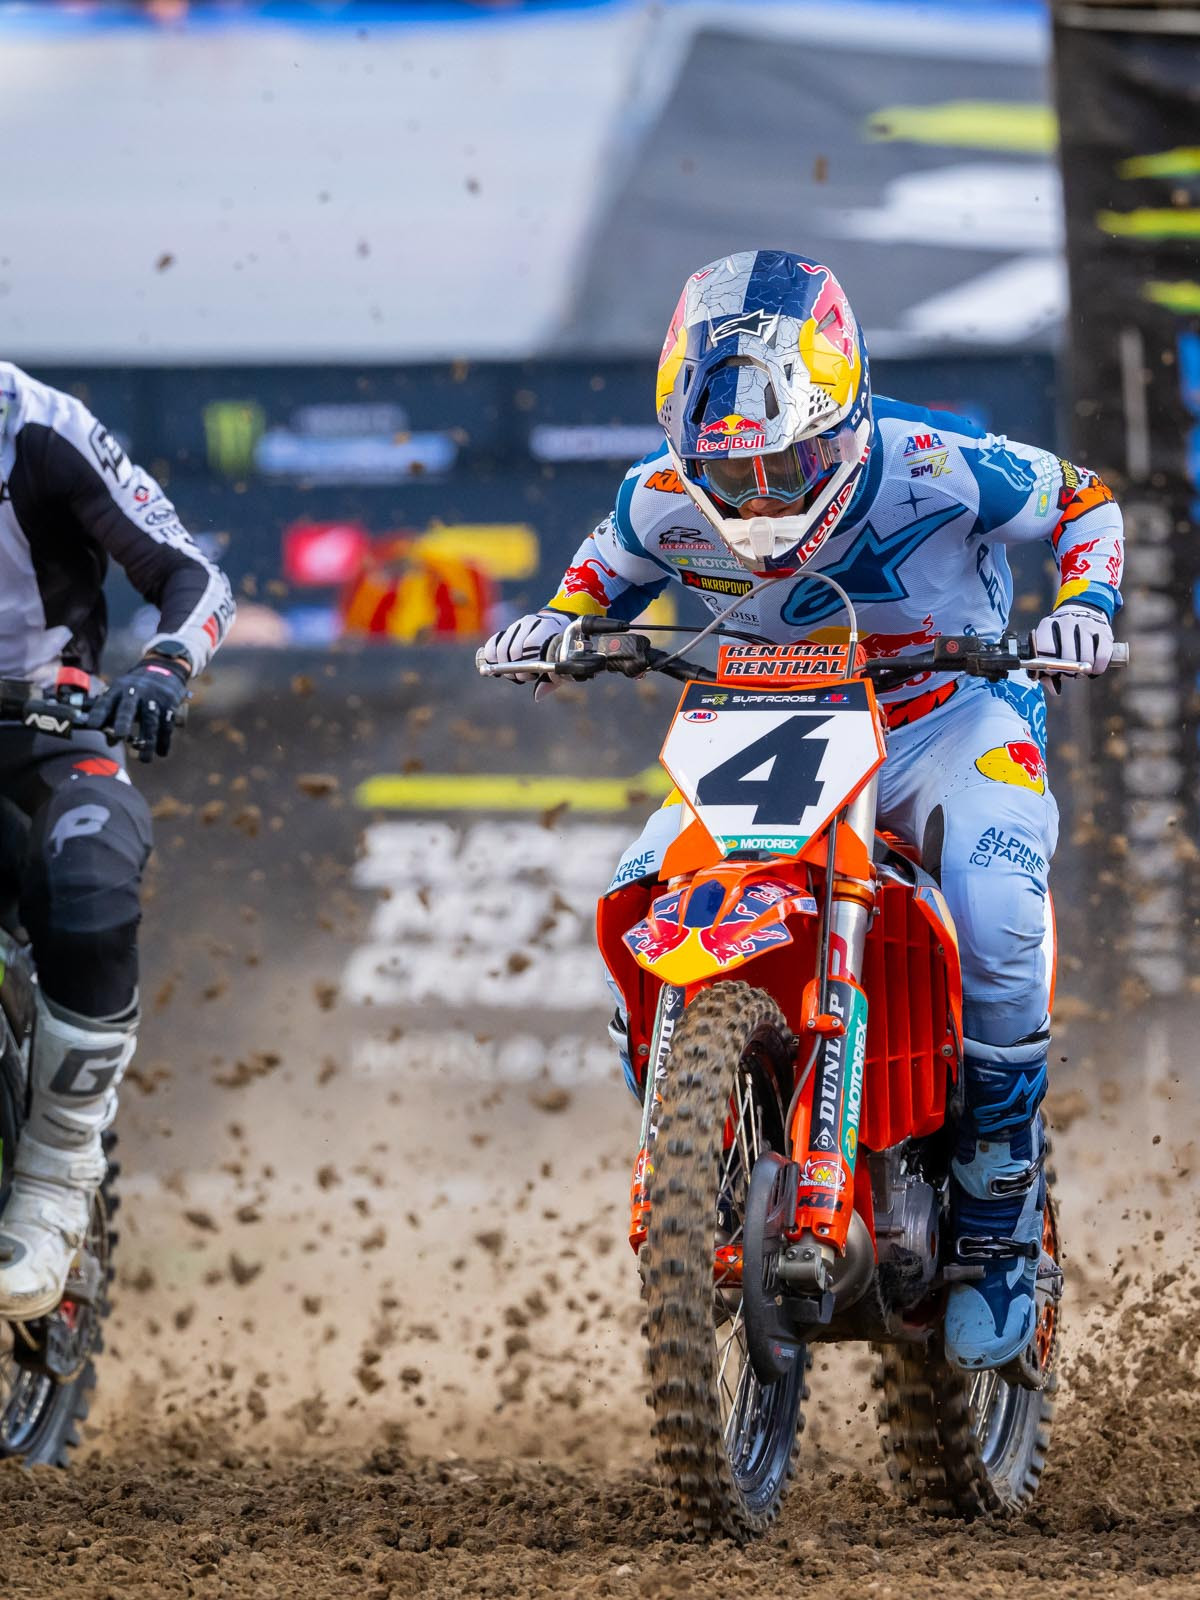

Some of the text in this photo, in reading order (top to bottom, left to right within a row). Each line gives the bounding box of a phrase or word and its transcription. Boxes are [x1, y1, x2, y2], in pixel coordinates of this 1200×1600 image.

[696, 434, 766, 452] Red Bull
[903, 433, 944, 455] AMA
[692, 555, 746, 571] MOTORE
[725, 644, 846, 658] RENTHAL
[724, 659, 845, 676] RENTHAL
[731, 695, 817, 703] SUPERCROSS
[694, 714, 837, 826] 4
[739, 838, 799, 849] MOTOREX
[982, 826, 1046, 873] ALPINE
[619, 849, 656, 872] PINE
[975, 838, 1036, 875] STARS
[609, 865, 647, 887] ARS
[819, 992, 848, 1126] DUNLP
[846, 1017, 868, 1128] MOTOREX
